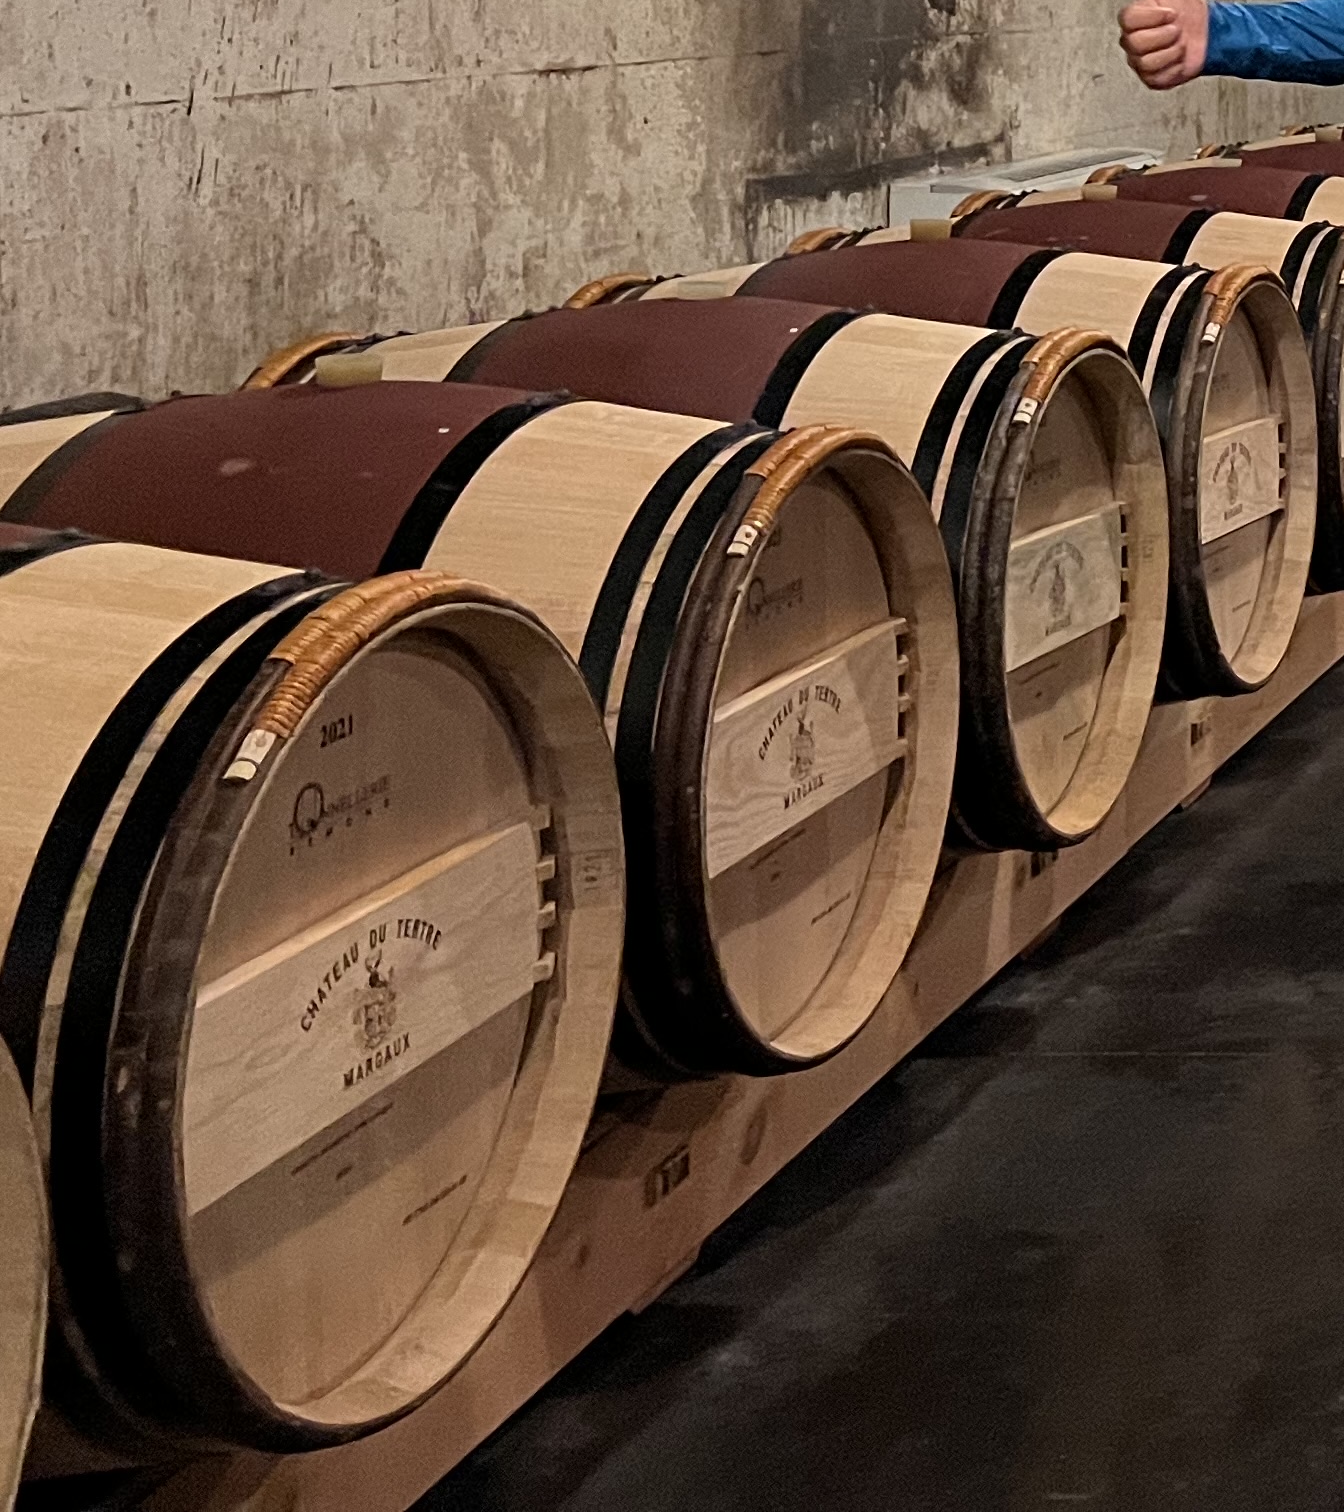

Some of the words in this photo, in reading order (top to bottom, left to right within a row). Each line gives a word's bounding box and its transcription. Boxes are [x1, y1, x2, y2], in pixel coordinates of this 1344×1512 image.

[320, 714, 353, 748] 2021
[300, 942, 359, 1032] CHATEAU
[369, 922, 387, 949] DU
[397, 918, 442, 951] TERTRE
[343, 1031, 411, 1087] MARGAUX
